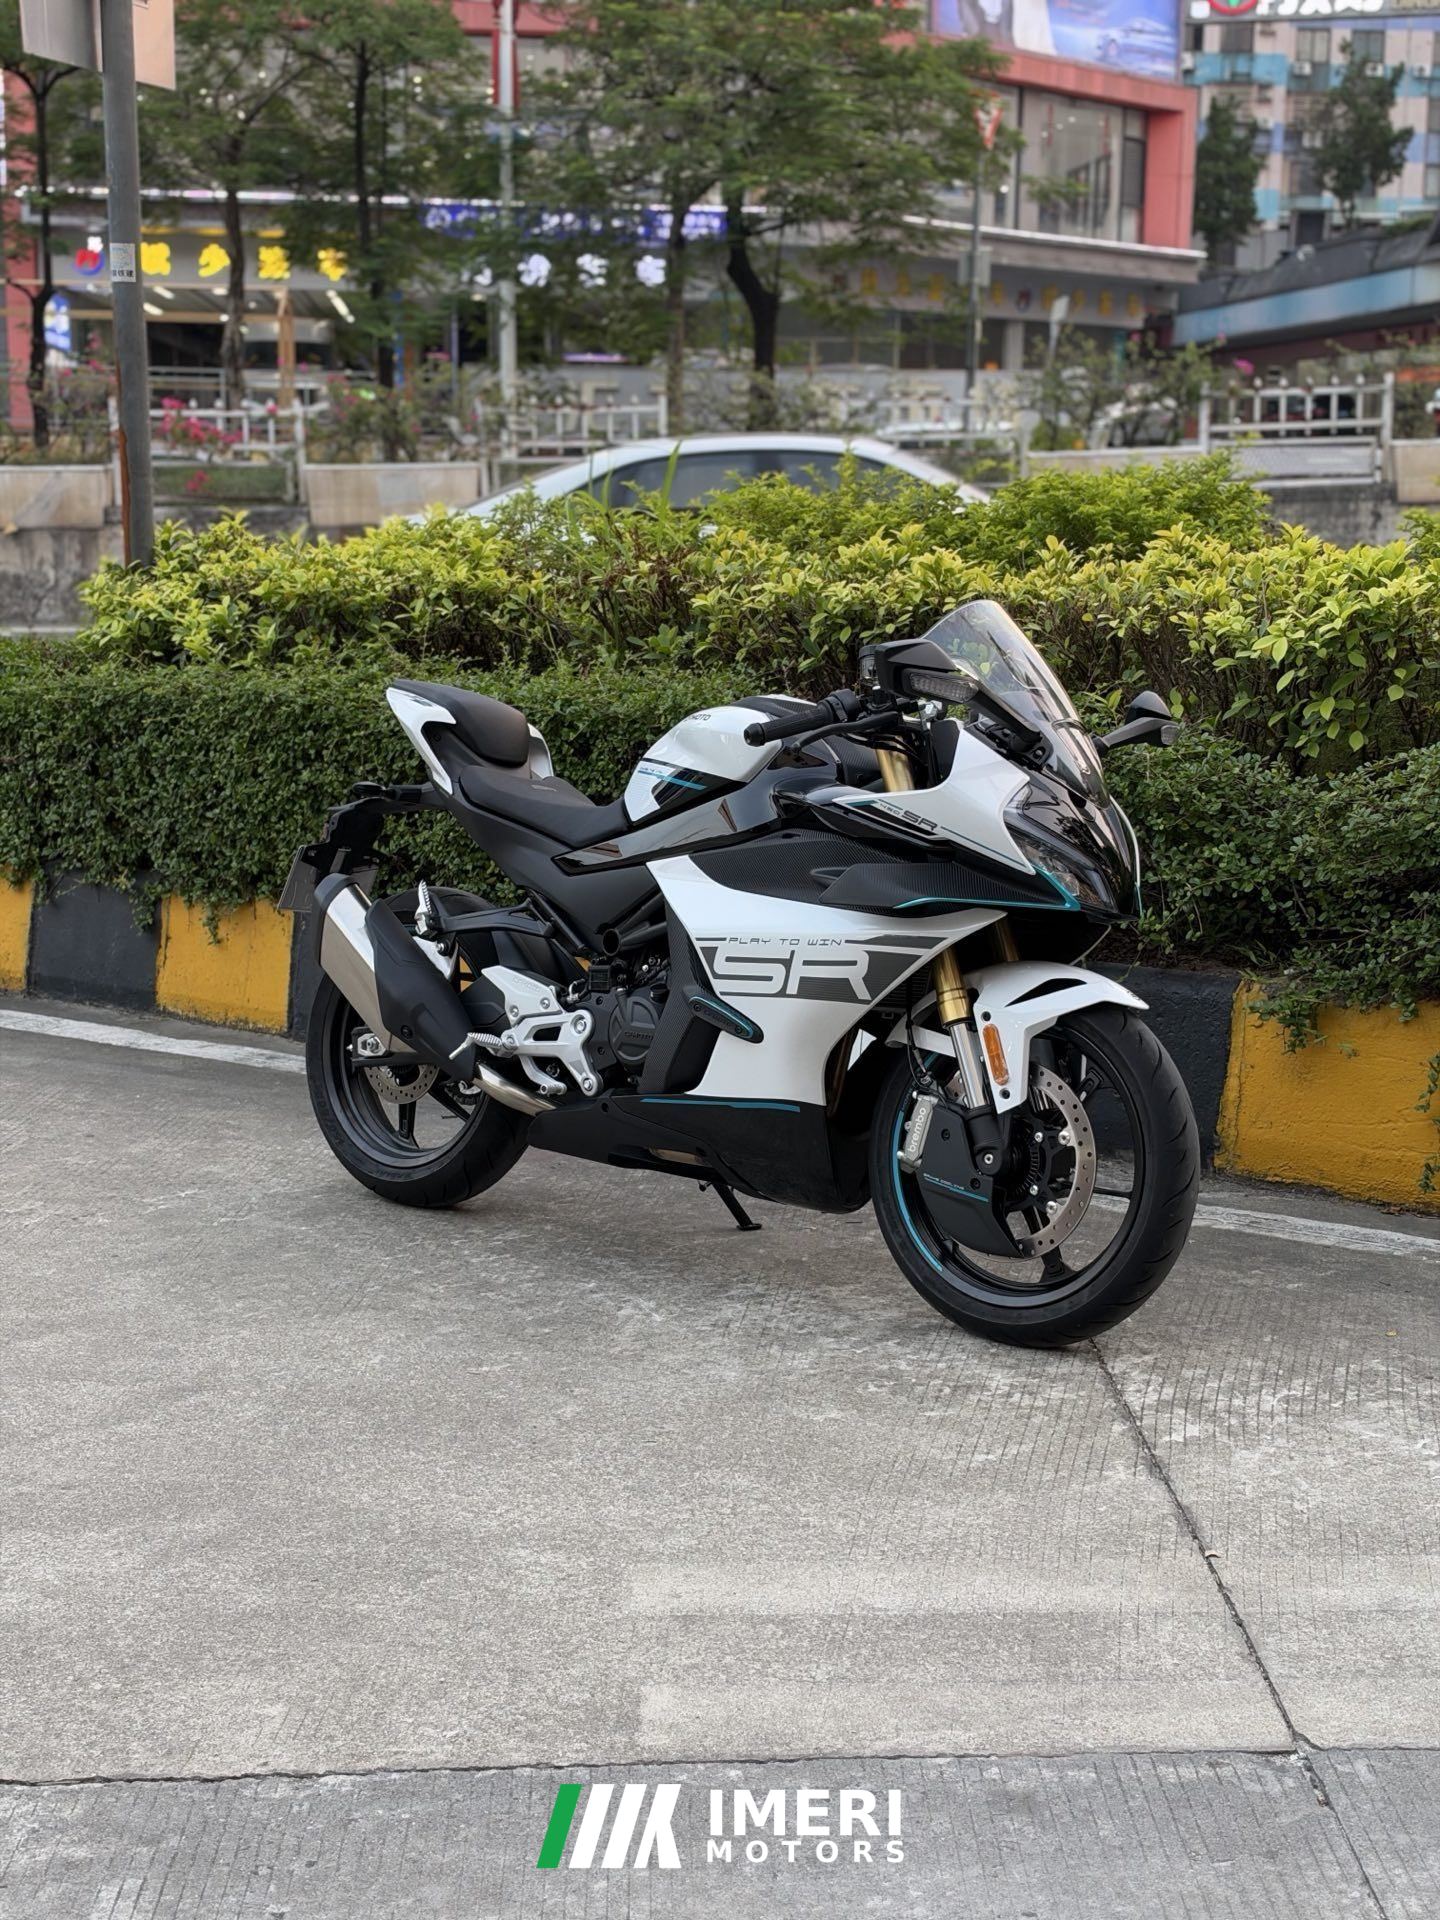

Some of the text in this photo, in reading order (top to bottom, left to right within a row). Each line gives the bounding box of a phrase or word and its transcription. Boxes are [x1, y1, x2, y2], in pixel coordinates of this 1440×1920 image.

[901, 810, 938, 831] SR
[728, 937, 843, 946] PLAY TO WIN
[713, 946, 872, 1001] SR
[908, 1107, 927, 1152] brembo
